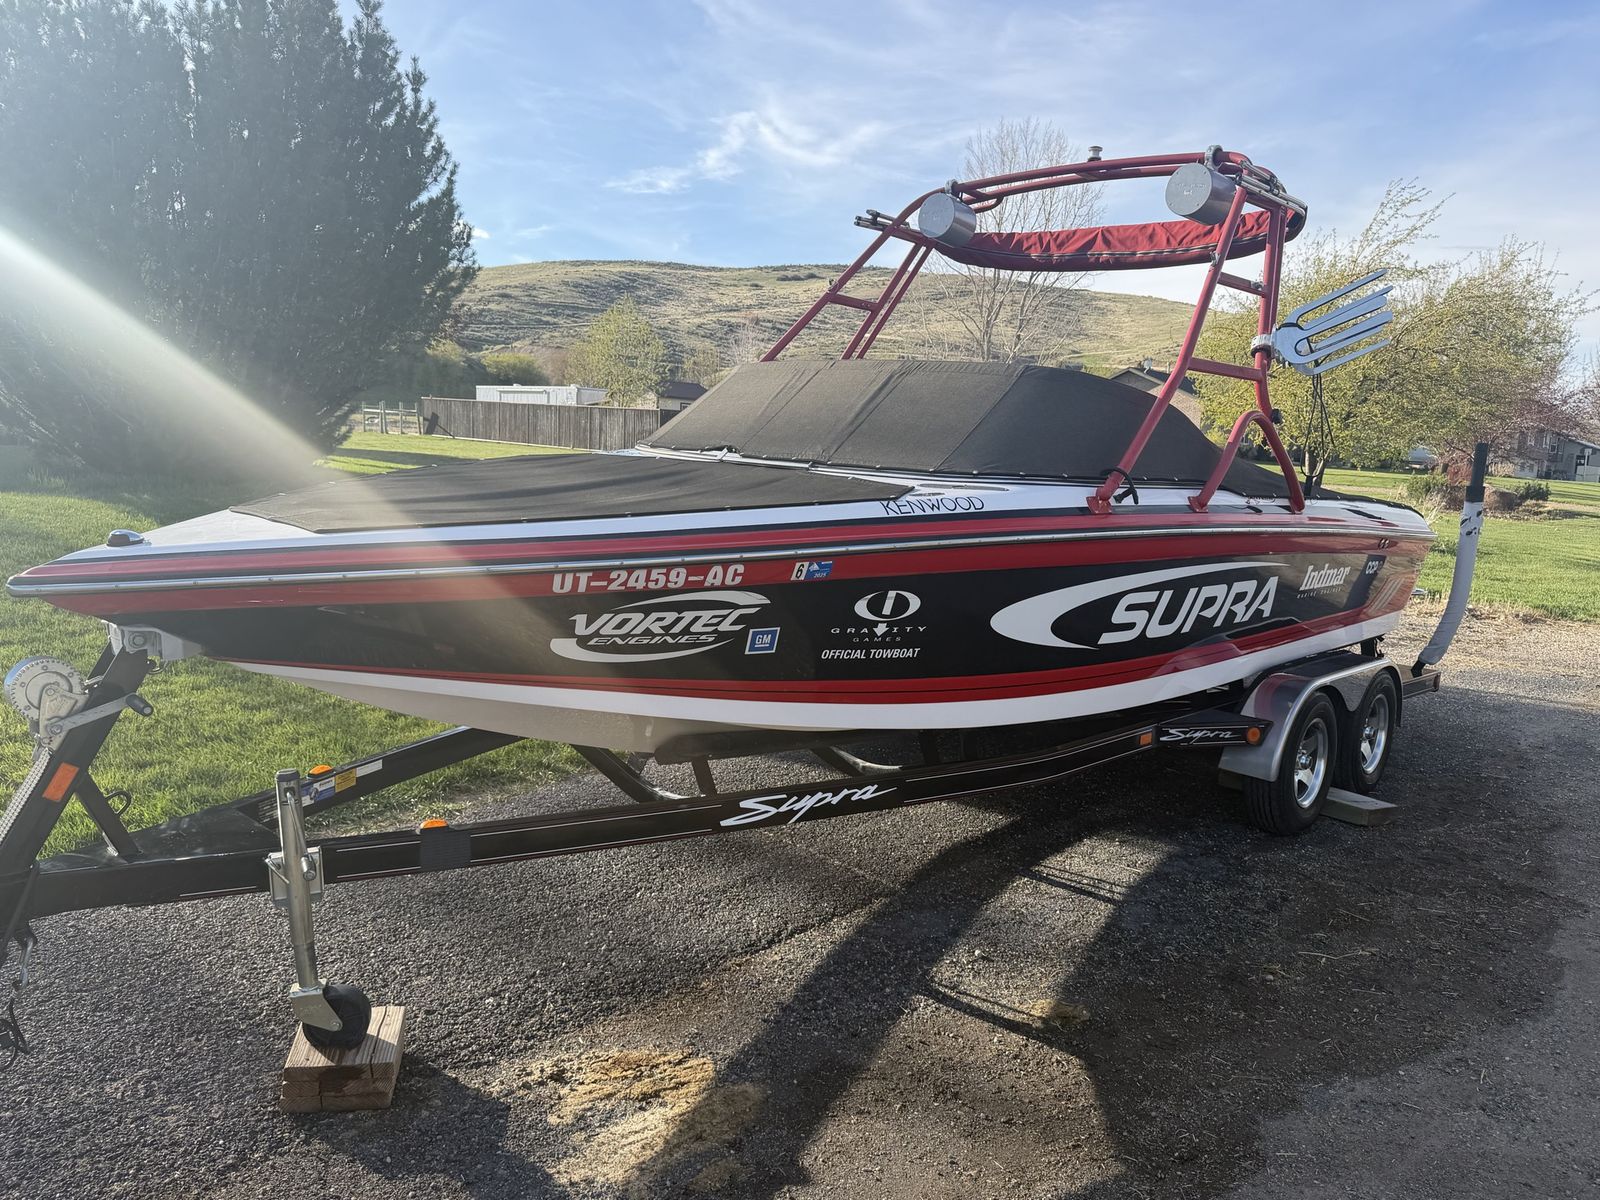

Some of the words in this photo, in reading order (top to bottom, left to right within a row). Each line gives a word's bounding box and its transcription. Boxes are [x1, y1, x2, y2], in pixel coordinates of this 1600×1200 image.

[881, 496, 985, 515] KENWOOD
[552, 564, 745, 594] UT-2459-AC
[795, 563, 805, 579] 6
[1299, 563, 1351, 591] Indmar
[1097, 576, 1280, 645] SUPRA
[568, 607, 762, 636] VORTEC
[587, 634, 718, 646] ENGINES
[755, 634, 772, 644] GM
[821, 649, 867, 660] OFFICIAL
[869, 647, 921, 659] TOWBOAT
[1159, 727, 1241, 744] Supra
[719, 783, 898, 827] Supra
